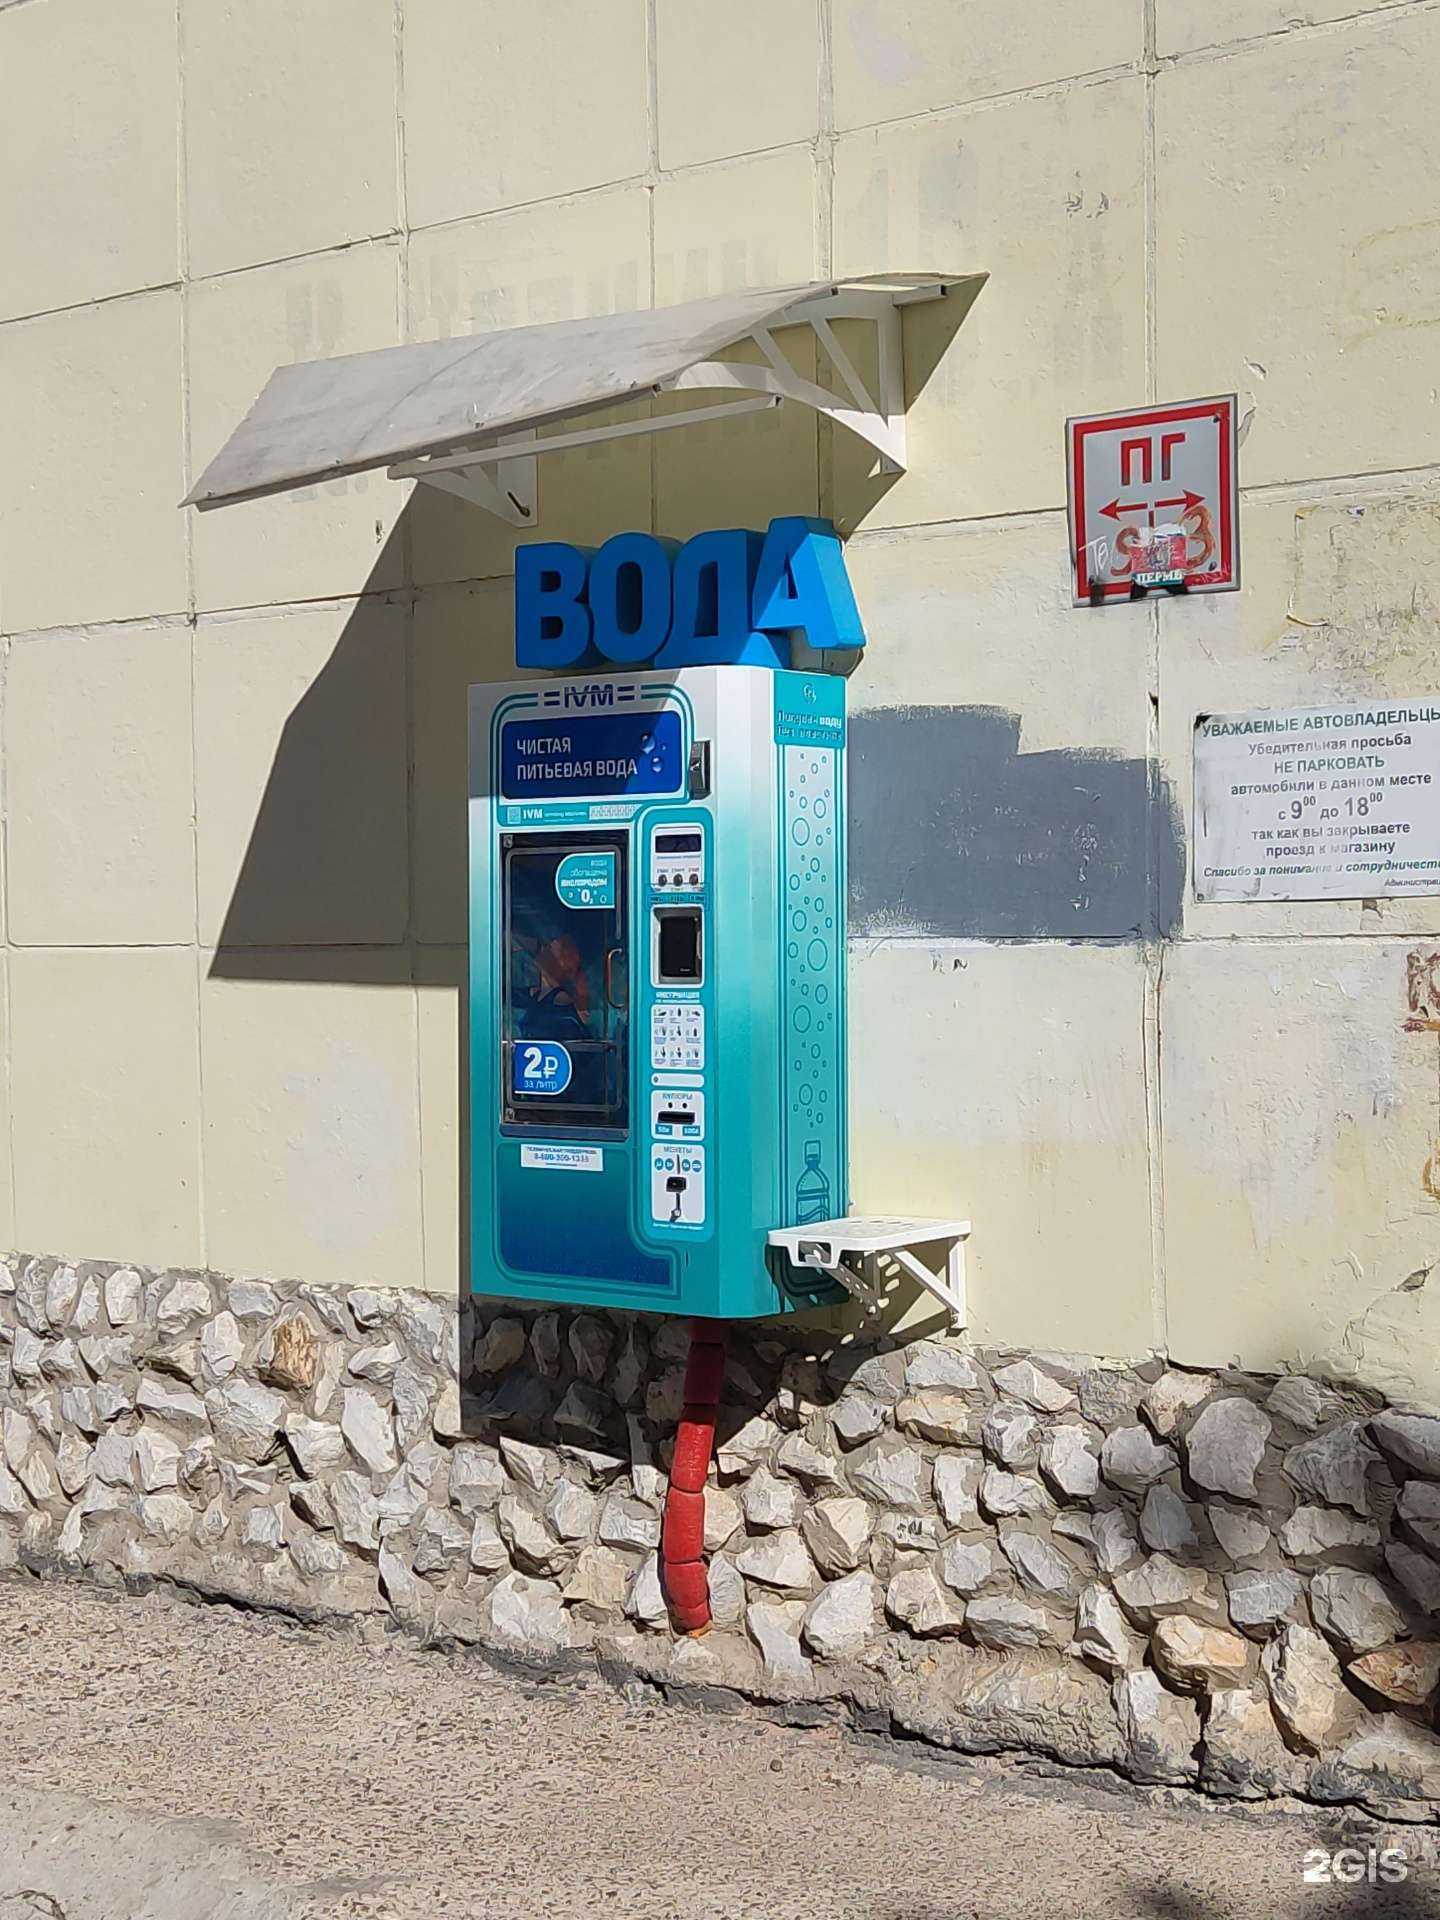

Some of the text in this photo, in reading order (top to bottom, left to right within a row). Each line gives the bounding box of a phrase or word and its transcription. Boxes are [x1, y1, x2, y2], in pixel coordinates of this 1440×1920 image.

[1121, 432, 1185, 486] ПГ
[515, 515, 866, 670] ВОДА
[1203, 718, 1299, 737] УВАЖАЕМЫЕ
[516, 737, 571, 755] ЧИСТАЯ
[1351, 733, 1412, 750] просьба
[517, 758, 638, 780] ПИТЬЕВАЯ ВОДА
[1274, 755, 1385, 774] НЕ ПАРКОВАТЬ
[1231, 774, 1432, 795] автомобили в данном месте
[523, 809, 543, 819] IVM
[1278, 810, 1286, 820] с
[1320, 807, 1339, 819] до
[1252, 823, 1411, 840] так как вы закрываете
[1266, 845, 1315, 859] проезд
[1204, 865, 1251, 877] Спасибо
[1254, 866, 1266, 875] за
[1346, 859, 1440, 874] сотрудничест
